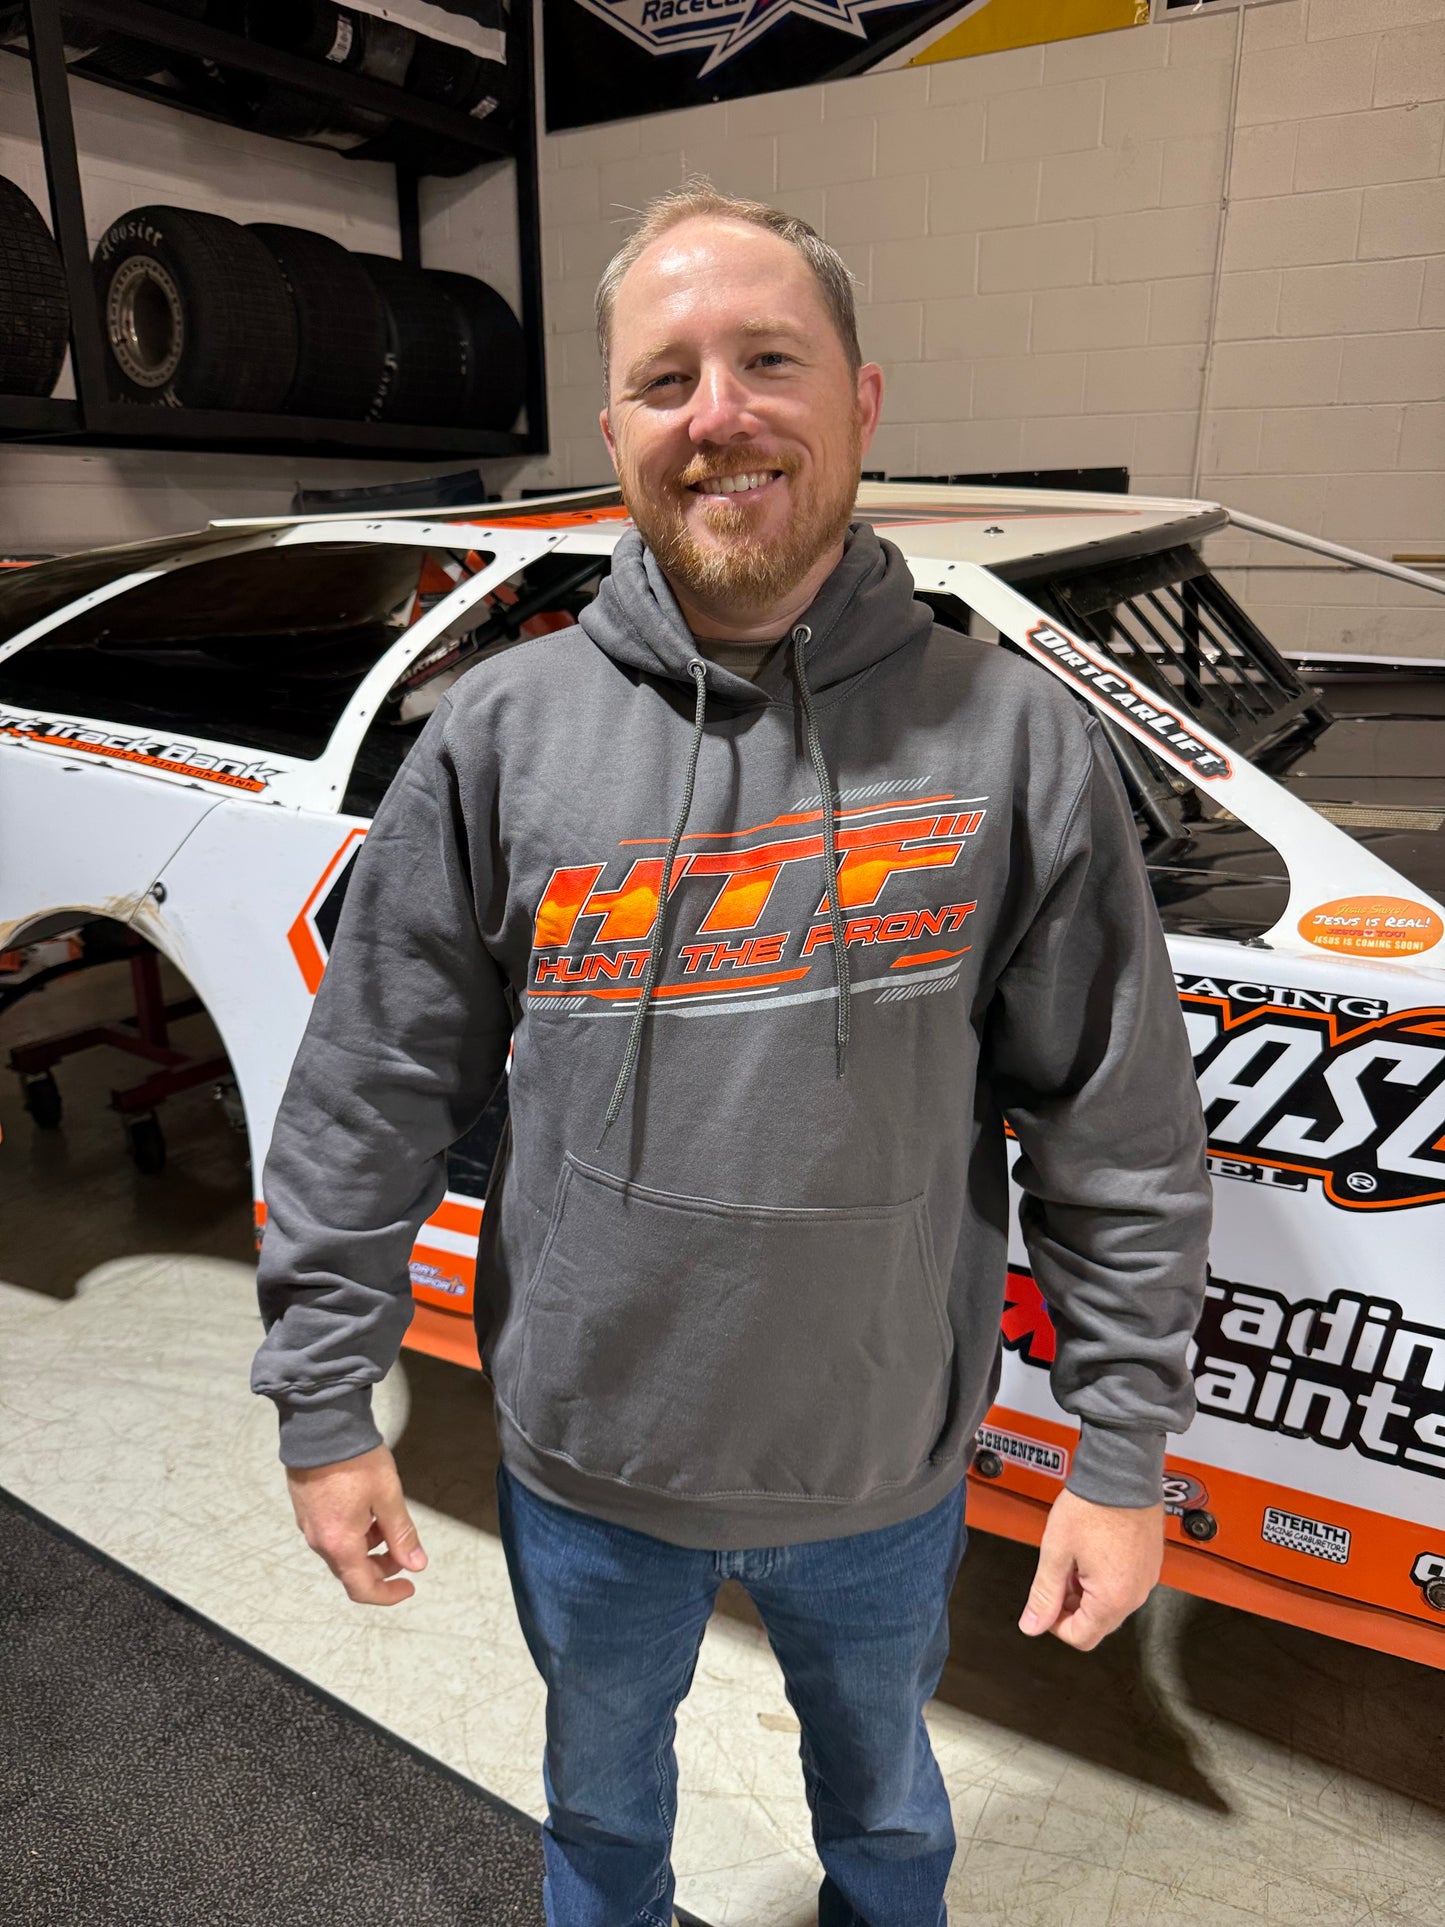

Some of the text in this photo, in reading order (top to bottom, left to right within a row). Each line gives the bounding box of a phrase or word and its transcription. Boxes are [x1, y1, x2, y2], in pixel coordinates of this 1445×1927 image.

[641, 0, 747, 26] Race
[45, 720, 159, 756] Track
[159, 742, 285, 785] Bank
[217, 775, 255, 789] BANK
[533, 809, 986, 949] HTF
[535, 900, 978, 984] HUNT THE FRONT
[1313, 936, 1424, 951] JESUS IS COMING SOON!
[976, 1428, 1061, 1471] SCHOENFELD
[1265, 1523, 1347, 1554] RACING CARBURETORS
[1268, 1510, 1347, 1544] STEALTH
